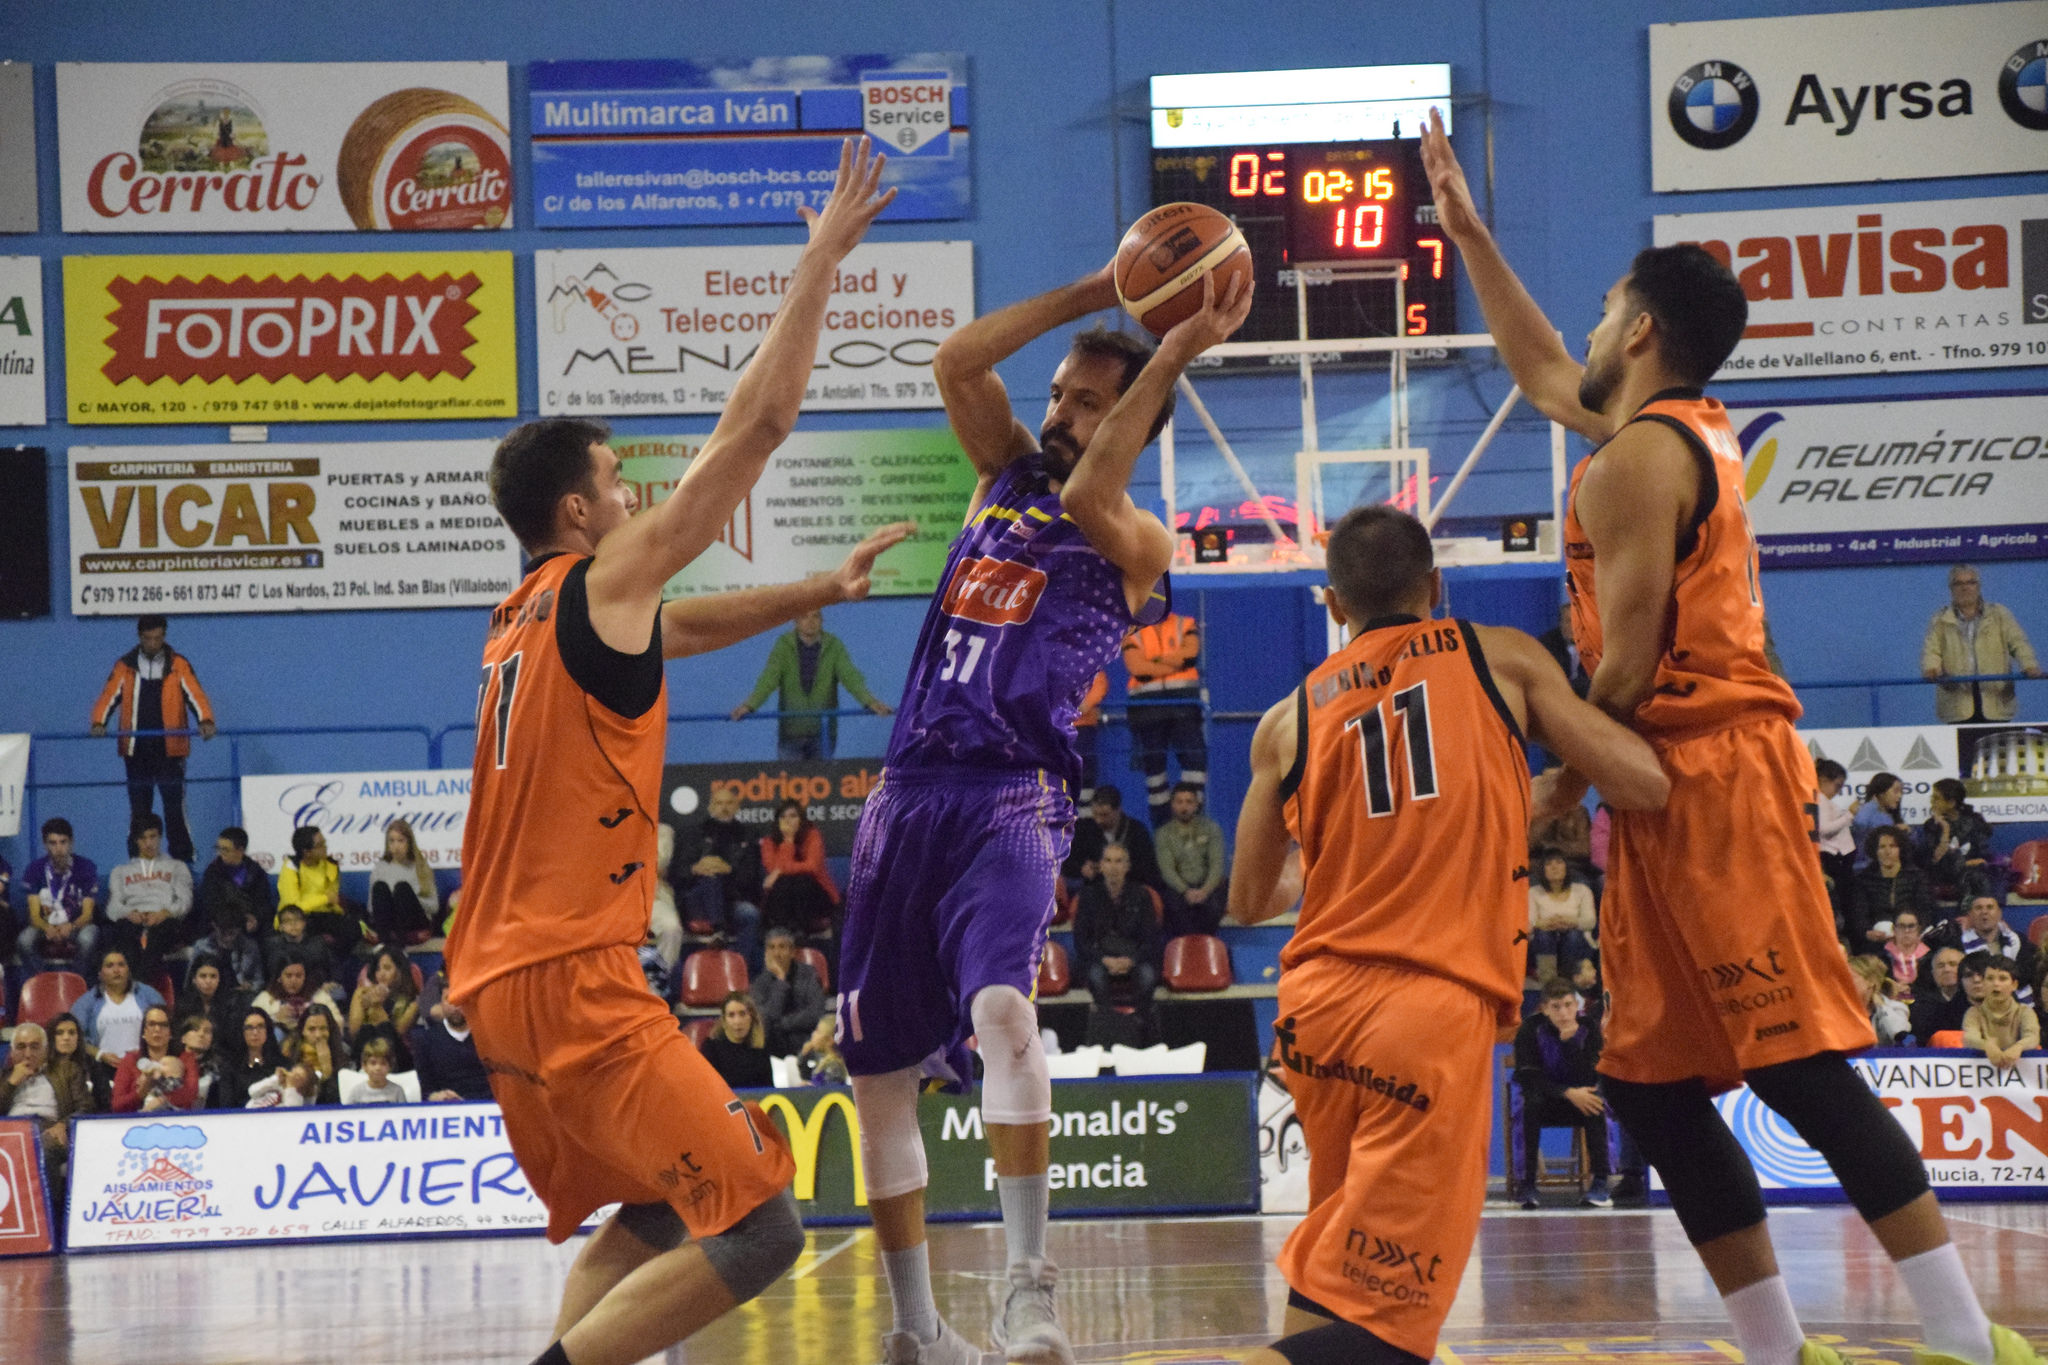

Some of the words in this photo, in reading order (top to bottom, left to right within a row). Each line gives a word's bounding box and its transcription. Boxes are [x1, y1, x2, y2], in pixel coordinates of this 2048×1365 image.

[2008, 43, 2048, 72] BM
[868, 85, 944, 104] BOSCH
[1785, 74, 1973, 136] Ayrsa
[545, 101, 716, 127] Multimarca
[724, 98, 789, 123] Iván
[868, 108, 944, 125] Service
[86, 151, 324, 219] Cerrato
[389, 168, 507, 216] Cerrato
[569, 195, 593, 211] de
[598, 195, 626, 211] los
[728, 192, 740, 209] 8
[1335, 204, 1384, 248] 10
[1677, 214, 2010, 302] avisa
[705, 267, 877, 296] Electrdad
[893, 273, 907, 297] y
[659, 303, 955, 334] Telecomcaciones
[1406, 304, 1427, 335] 5
[1820, 312, 2011, 335] CONTRATAS
[0, 350, 34, 375] tina
[1759, 355, 1780, 368] de
[1783, 351, 1866, 368] Vallellano
[1869, 349, 1886, 364] 6,
[1889, 348, 1922, 362] ent.
[1942, 344, 1986, 360] Tfno.
[1990, 342, 2022, 357] 979
[97, 402, 156, 414] MAYOR,
[159, 401, 186, 412] 120
[212, 400, 240, 412] 979
[243, 400, 269, 411] 747
[568, 391, 582, 406] de
[327, 472, 405, 487] PUERTAS
[410, 474, 419, 487] y
[1779, 472, 1994, 504] PALENCIA
[344, 496, 420, 509] COCINAS
[425, 497, 434, 510] y
[79, 483, 320, 549] VICAR
[339, 519, 419, 532] MUEBLES
[425, 521, 434, 530] a
[440, 516, 504, 530] MEDIDA
[334, 542, 400, 555] SUELOS
[406, 539, 506, 553] LAMINADOS
[1849, 539, 1878, 551] 4x4
[1893, 536, 1962, 550] Industrial
[86, 555, 302, 573] www.carpinteriavicar.es
[93, 587, 115, 603] 979
[118, 586, 138, 602] 712
[173, 585, 193, 601] 661
[197, 584, 218, 601] 873
[221, 584, 241, 600] 447
[263, 583, 283, 599] Los
[286, 581, 329, 600] Nardos,
[333, 581, 347, 597] 23
[350, 581, 370, 597] Pol.
[398, 579, 418, 595] San
[1344, 679, 1441, 818] 11
[359, 779, 472, 798] AMBULAN
[299, 1115, 505, 1145] AISLAMIENT
[941, 1100, 1177, 1141] Monald's
[984, 1155, 1148, 1191] Pencia
[1991, 1166, 2046, 1182] 72-74
[103, 1179, 213, 1194] AISLAMIENTOS
[83, 1196, 202, 1223] JAVIER
[322, 1219, 368, 1232] CALLE
